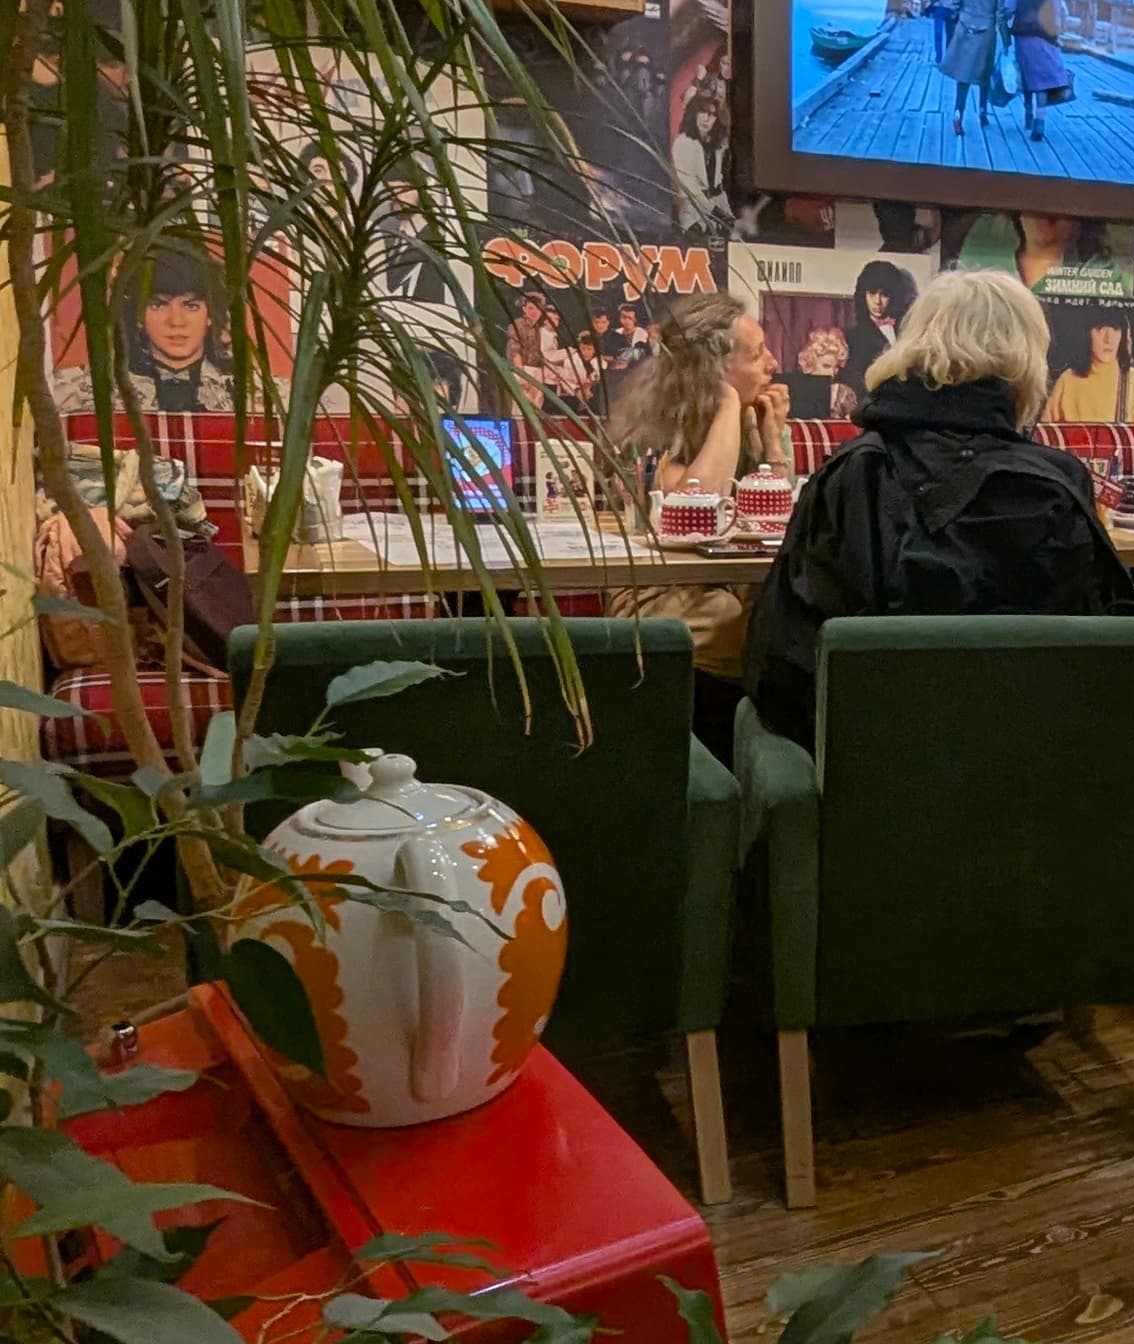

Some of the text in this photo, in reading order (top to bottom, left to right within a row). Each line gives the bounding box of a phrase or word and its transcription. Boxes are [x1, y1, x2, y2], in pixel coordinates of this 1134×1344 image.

[482, 236, 718, 301] ФОРУМ
[1045, 277, 1125, 297] ЗИМНИЙ САД
